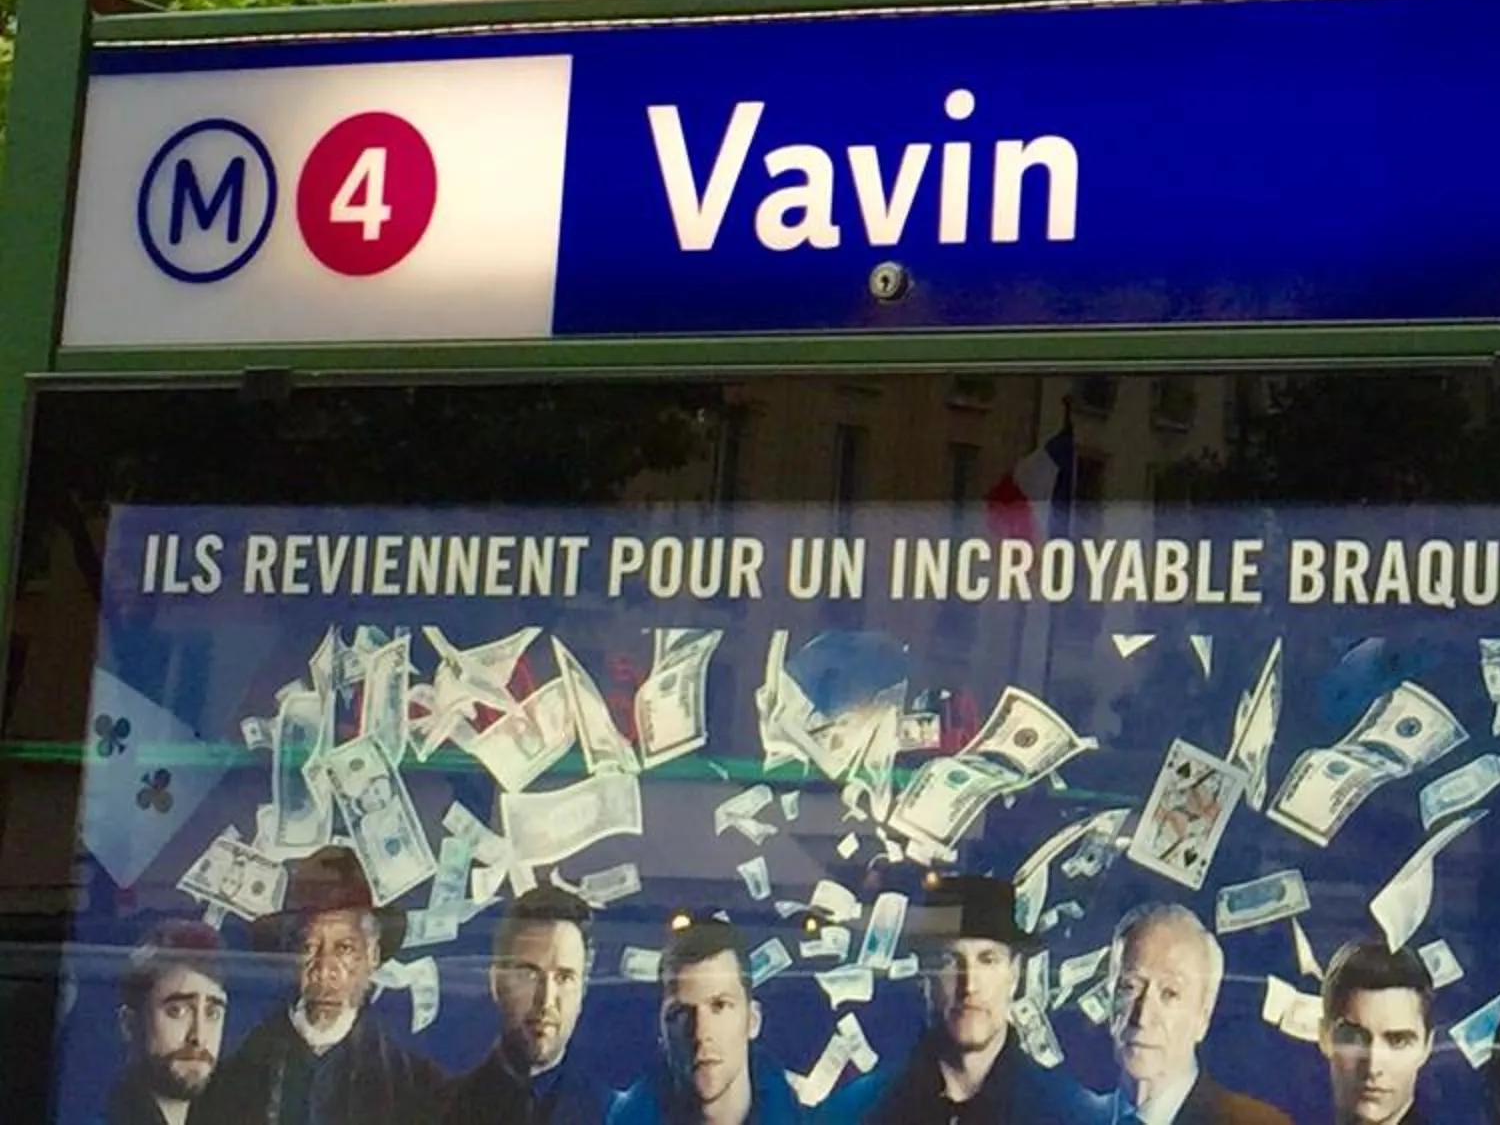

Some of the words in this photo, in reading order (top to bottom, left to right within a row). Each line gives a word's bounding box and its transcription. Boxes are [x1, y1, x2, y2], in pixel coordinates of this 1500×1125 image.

[330, 147, 391, 241] 4
[646, 87, 1080, 253] Vavin
[143, 533, 225, 595] ILS
[243, 534, 590, 598] REVIENNENT
[607, 535, 765, 600] POUR
[788, 536, 867, 600] UN
[889, 536, 1265, 604] INCROYABLE
